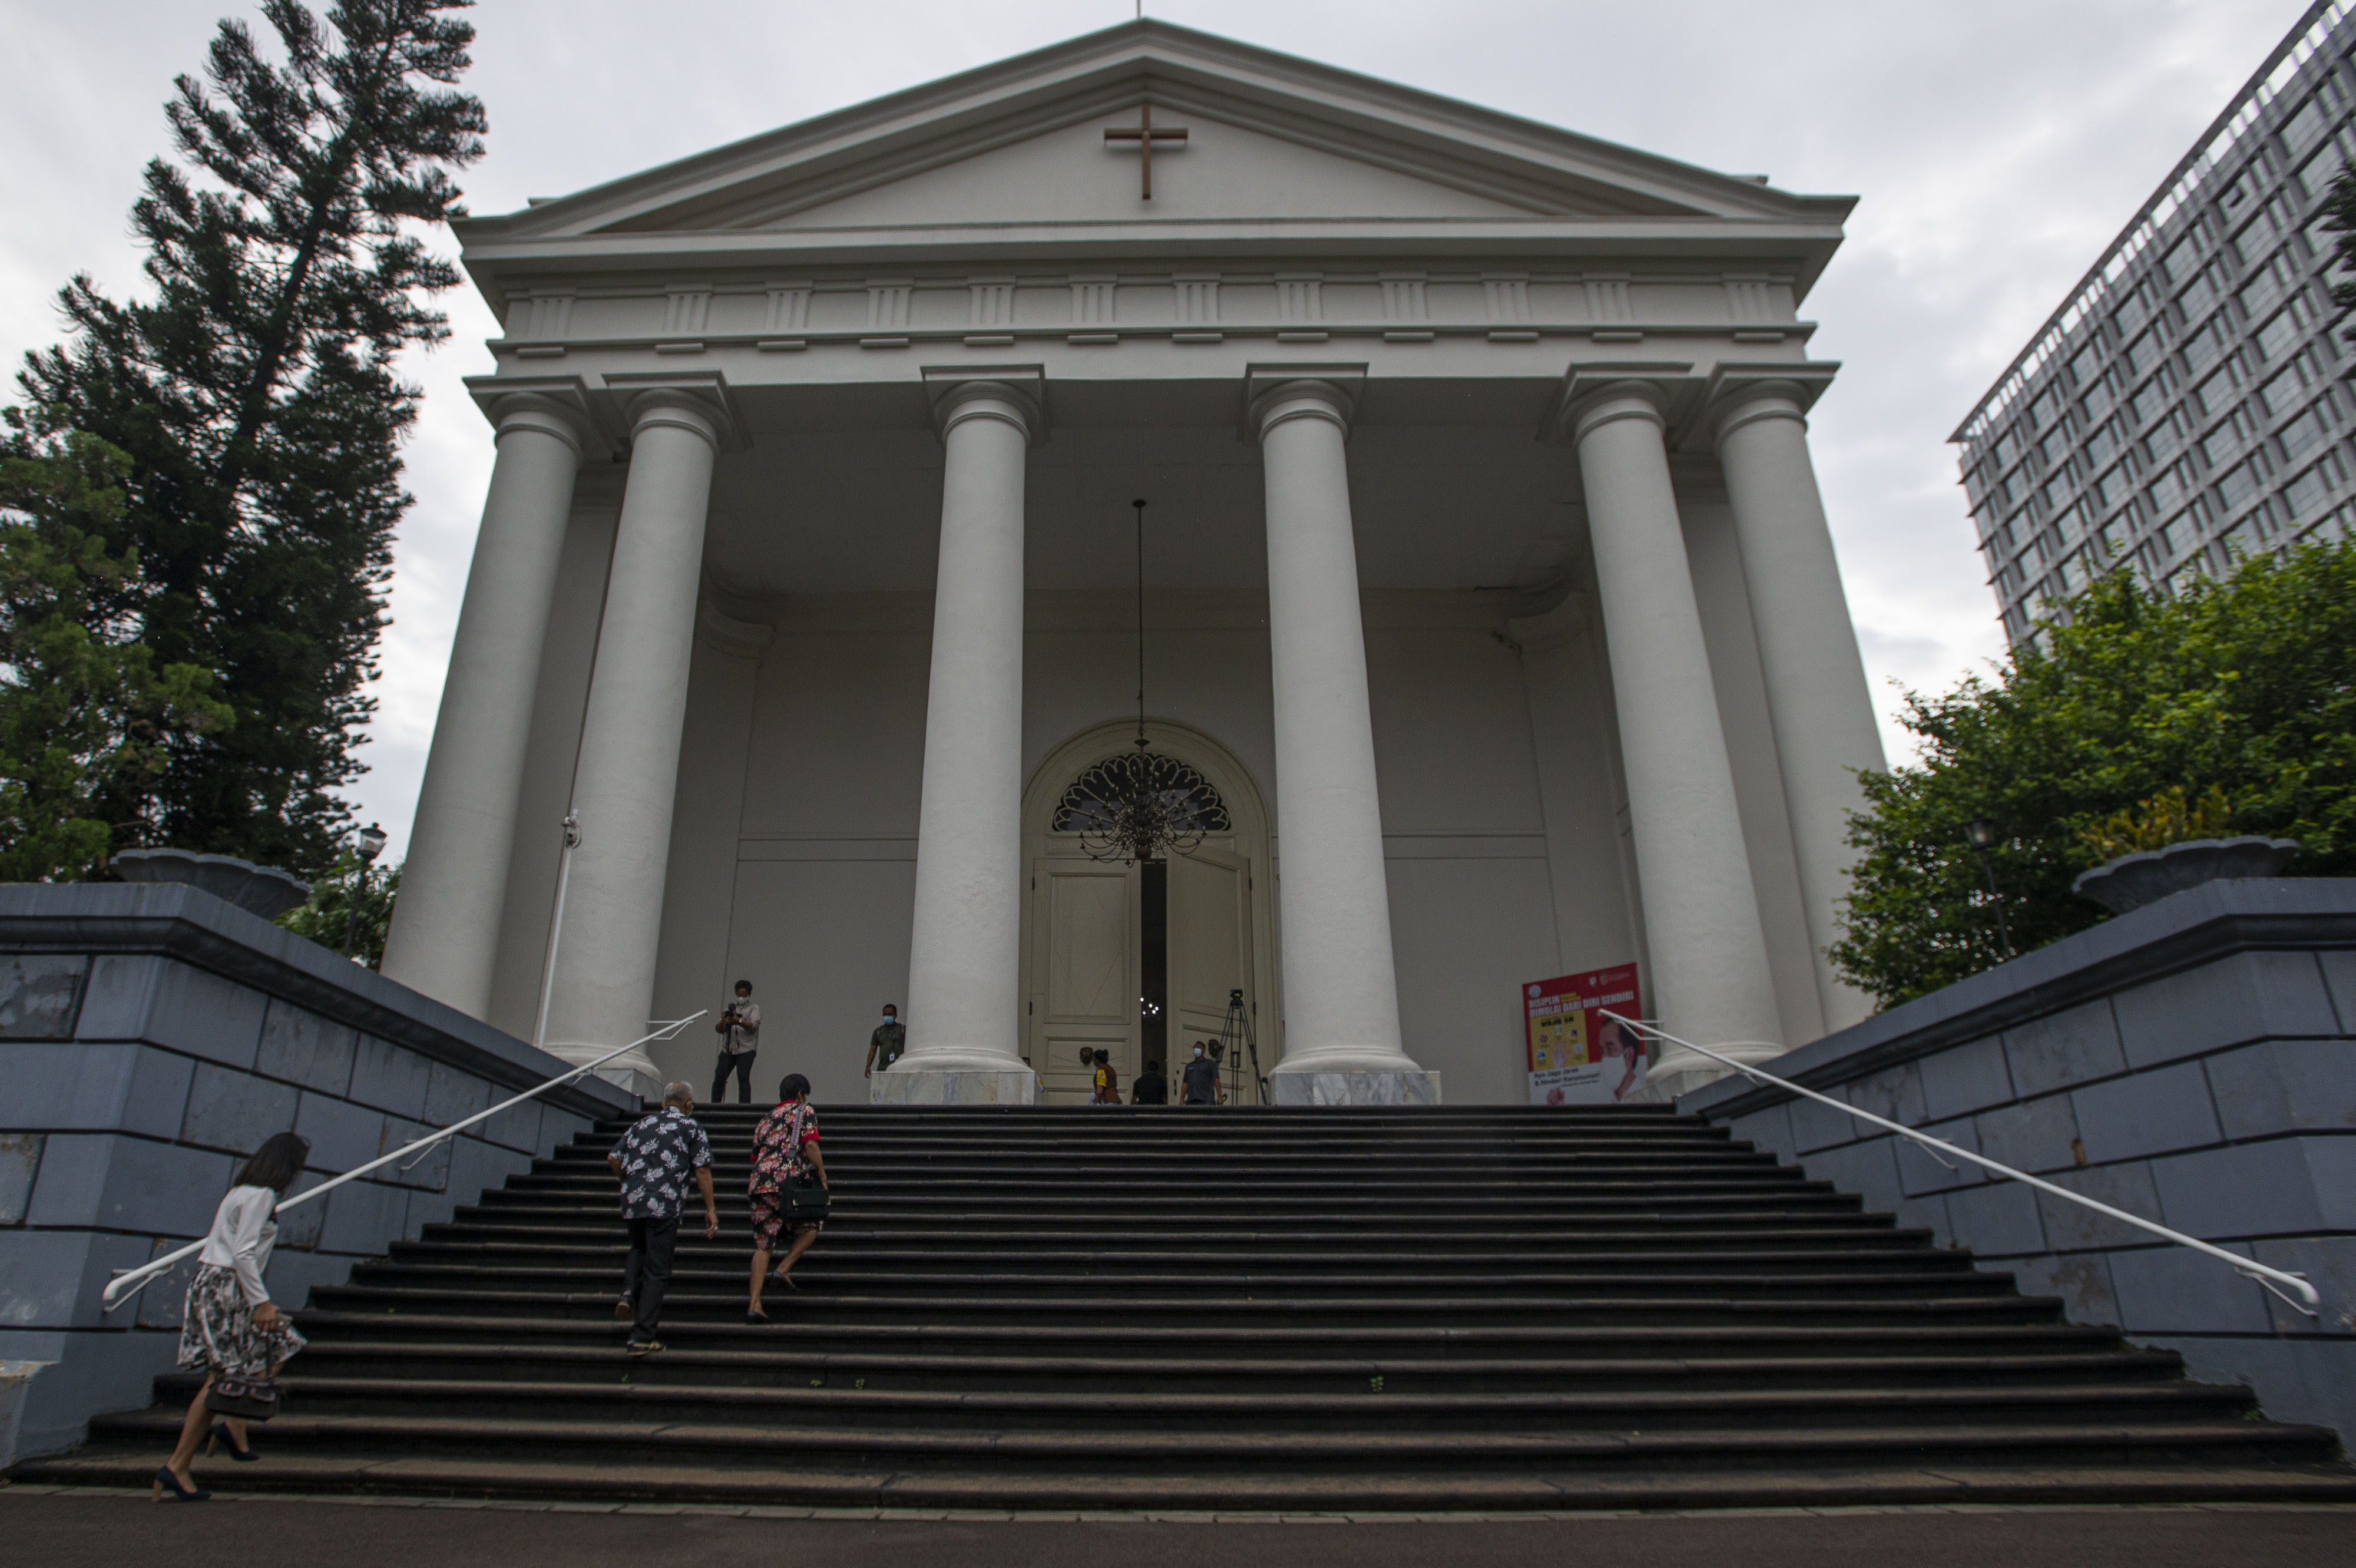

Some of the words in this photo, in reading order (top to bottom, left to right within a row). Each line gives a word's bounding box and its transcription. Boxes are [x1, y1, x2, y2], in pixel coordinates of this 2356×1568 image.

[1529, 995, 1560, 1008] DISIPLIN
[1530, 1004, 1561, 1017] DIMULAI
[1563, 1001, 1581, 1013] DARI
[1583, 997, 1600, 1008] DIRI
[1601, 991, 1633, 1005] SENDIRI
